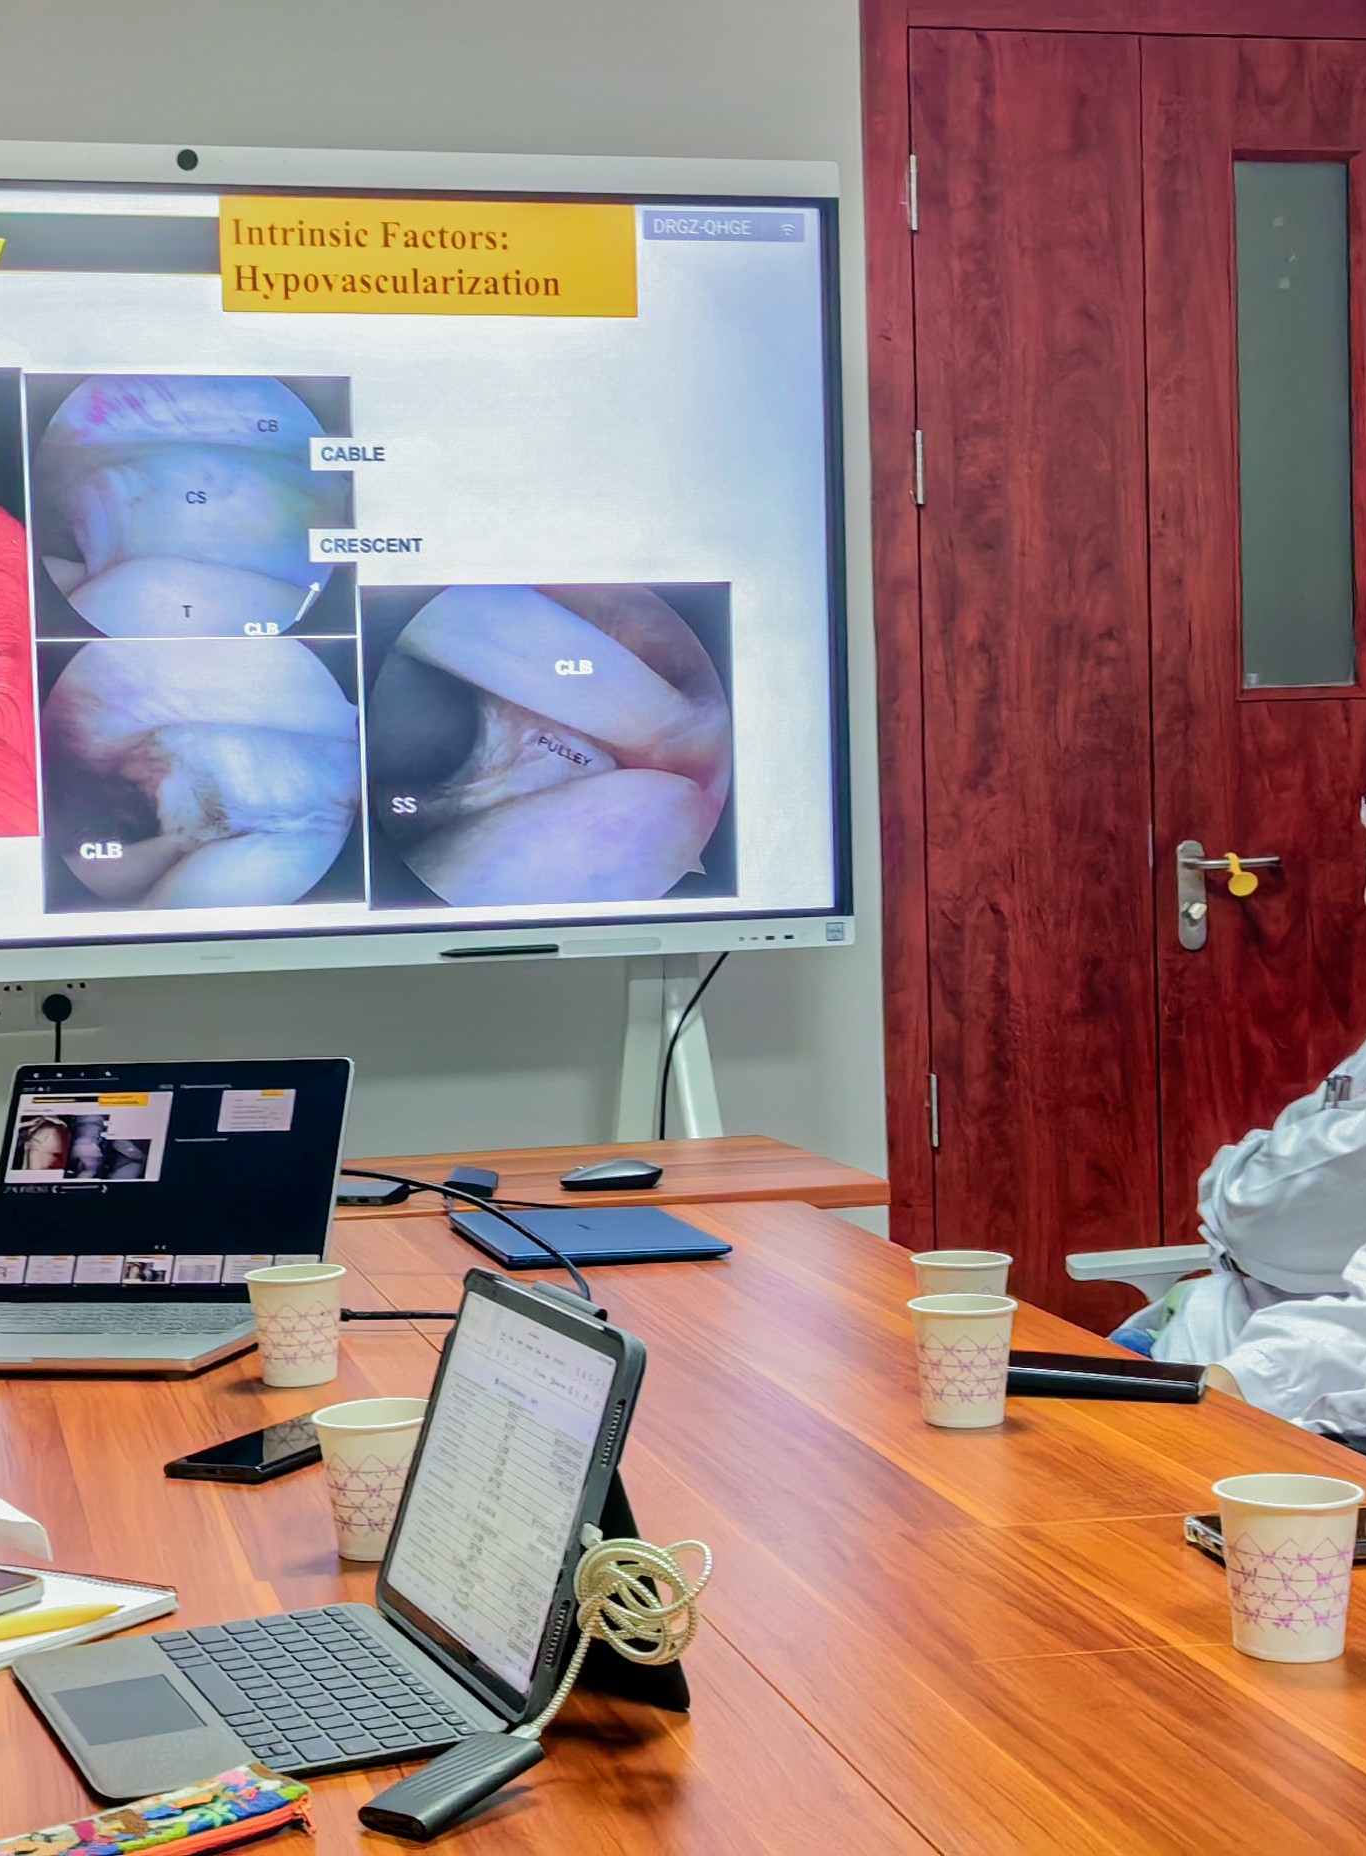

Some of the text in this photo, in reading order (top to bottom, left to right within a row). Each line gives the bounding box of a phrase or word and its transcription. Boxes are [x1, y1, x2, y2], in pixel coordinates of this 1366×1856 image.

[232, 217, 509, 252] Intrinsic Factors:
[233, 265, 560, 300] Hypovascularization
[257, 419, 278, 432] CB
[321, 446, 385, 461] CABLE
[185, 490, 207, 505] CS
[320, 538, 423, 553] CRESCENT
[182, 605, 192, 617] T
[244, 623, 279, 635] CLB
[555, 660, 593, 675] CLB
[538, 736, 593, 766] PULLEY
[392, 797, 418, 813] SS
[80, 842, 122, 859] CLB
